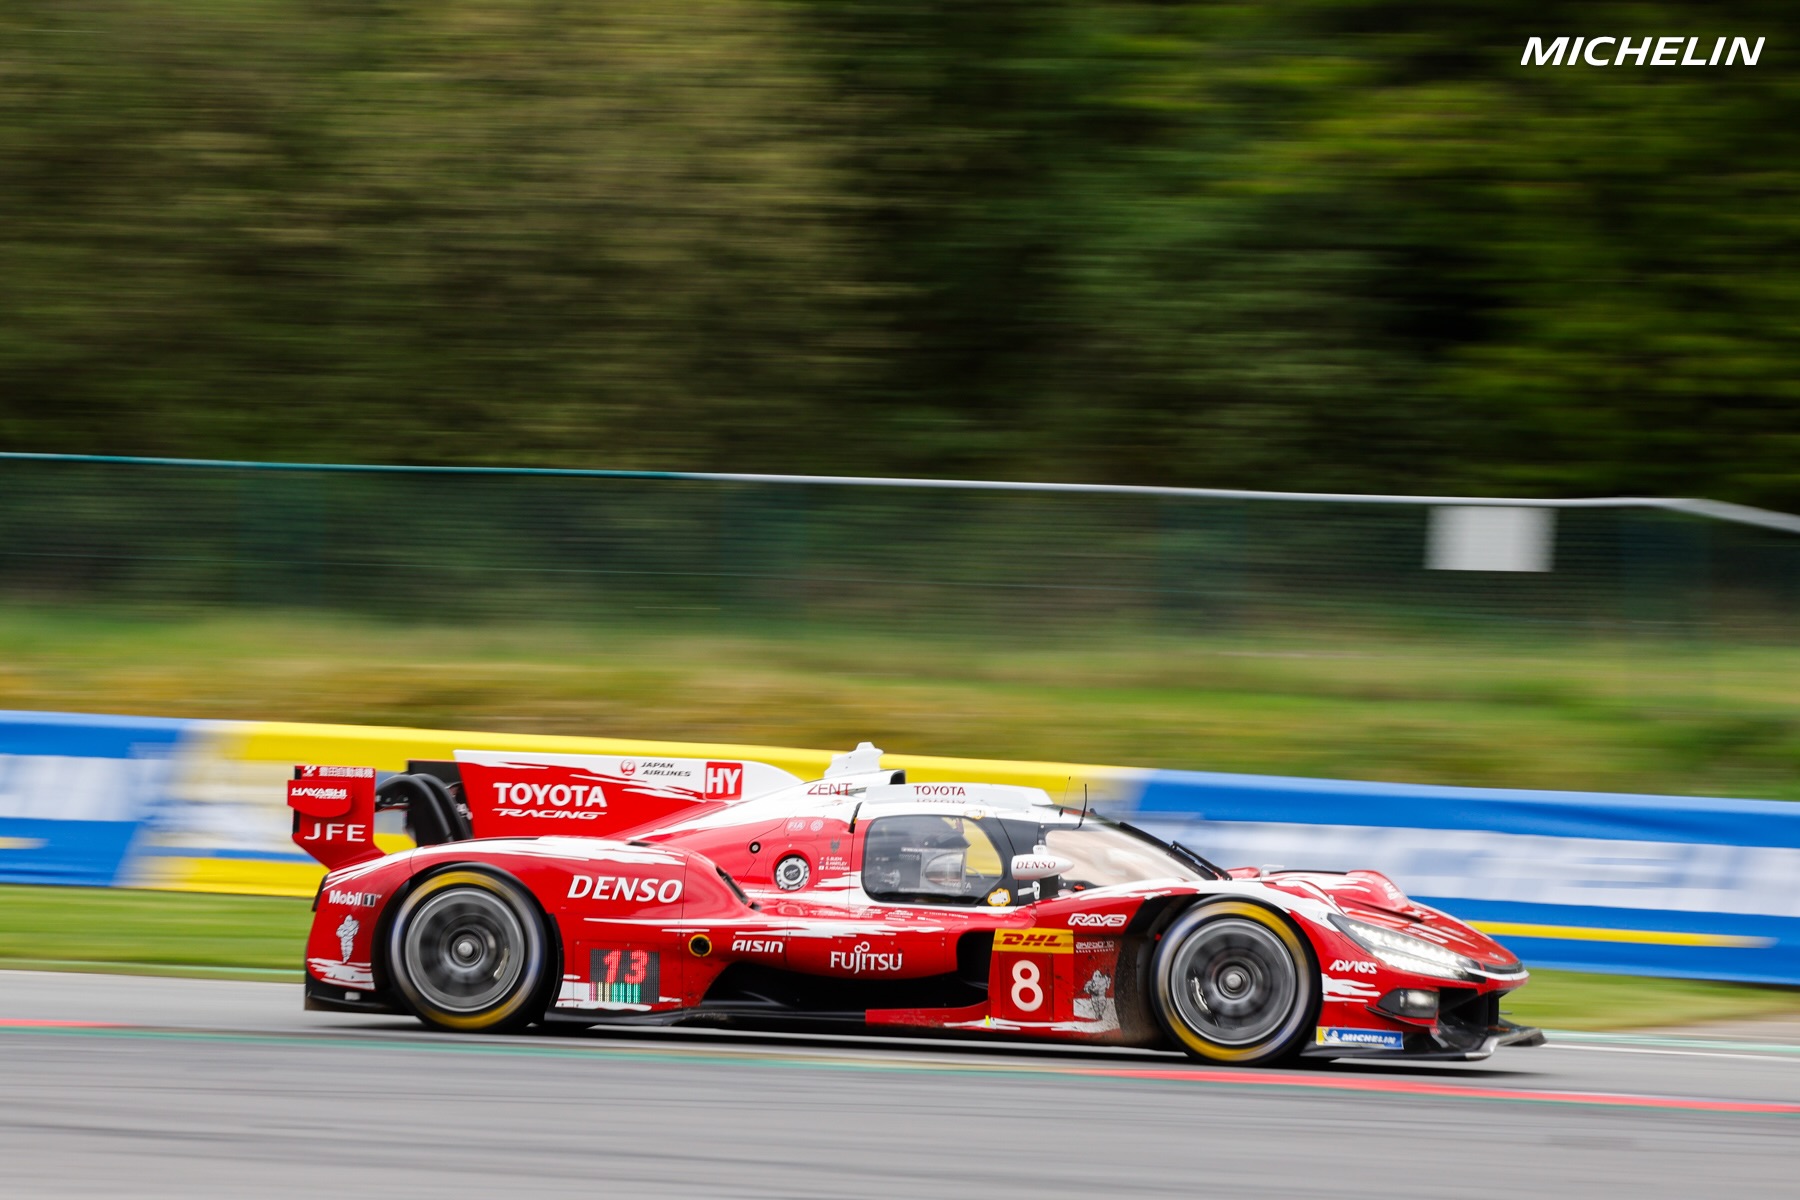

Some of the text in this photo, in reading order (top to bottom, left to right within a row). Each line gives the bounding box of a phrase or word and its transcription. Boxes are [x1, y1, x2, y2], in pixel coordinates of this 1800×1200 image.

[641, 761, 674, 769] JAPAN
[643, 769, 691, 777] AIRLINES
[707, 767, 741, 794] HY
[291, 787, 347, 798] HAYASHI
[493, 782, 608, 807] TOYOTA
[807, 783, 852, 796] ZENT
[914, 785, 966, 796] TOYOTA
[492, 808, 607, 820] RACING
[304, 823, 366, 842] JFE
[1016, 861, 1056, 870] DENSO
[567, 874, 683, 903] DENSO
[328, 890, 376, 907] Mobil 1
[1068, 913, 1127, 927] RAYS
[732, 939, 783, 953] AISIN
[1002, 933, 1062, 947] DHL
[830, 941, 903, 974] FUJITSU
[603, 949, 649, 985] 13
[1011, 960, 1044, 1012] 8
[1341, 1033, 1396, 1045] MICHELIN
